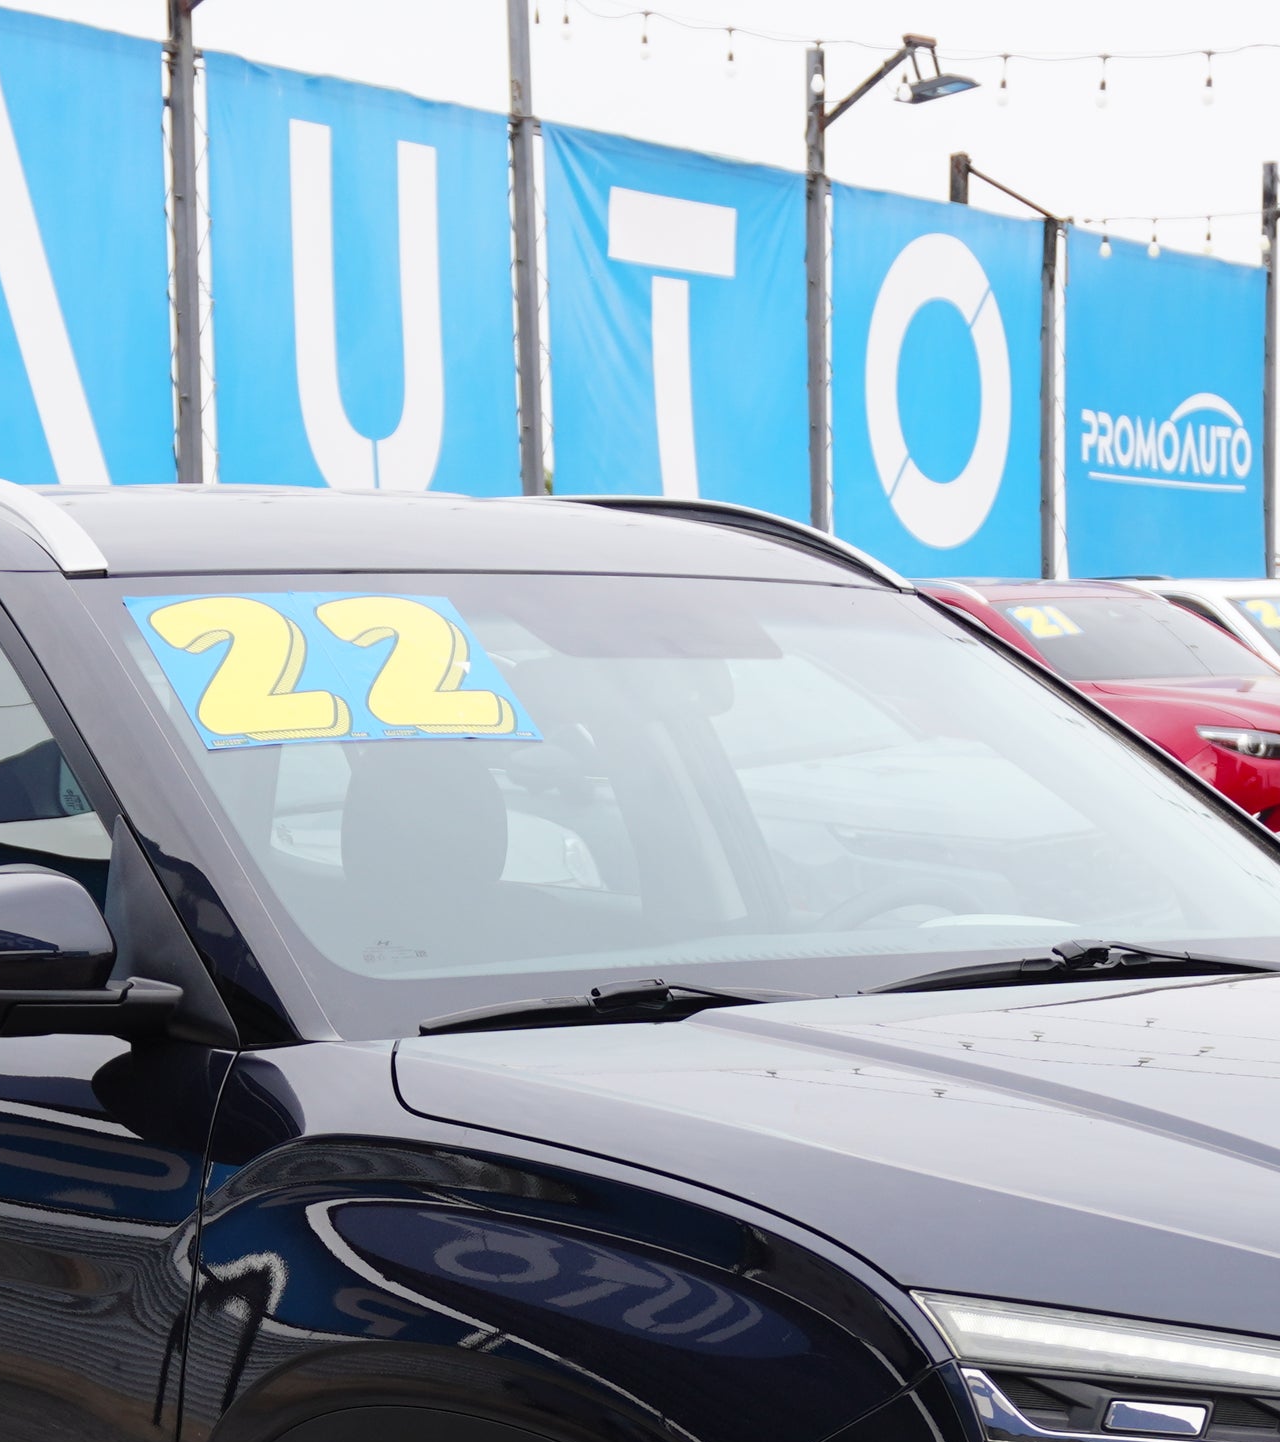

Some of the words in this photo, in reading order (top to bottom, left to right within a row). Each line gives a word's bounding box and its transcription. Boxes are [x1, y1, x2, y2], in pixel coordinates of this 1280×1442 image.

[1081, 408, 1253, 479] PROMOAUTO
[1014, 606, 1081, 638] 21
[148, 594, 518, 741] 22
